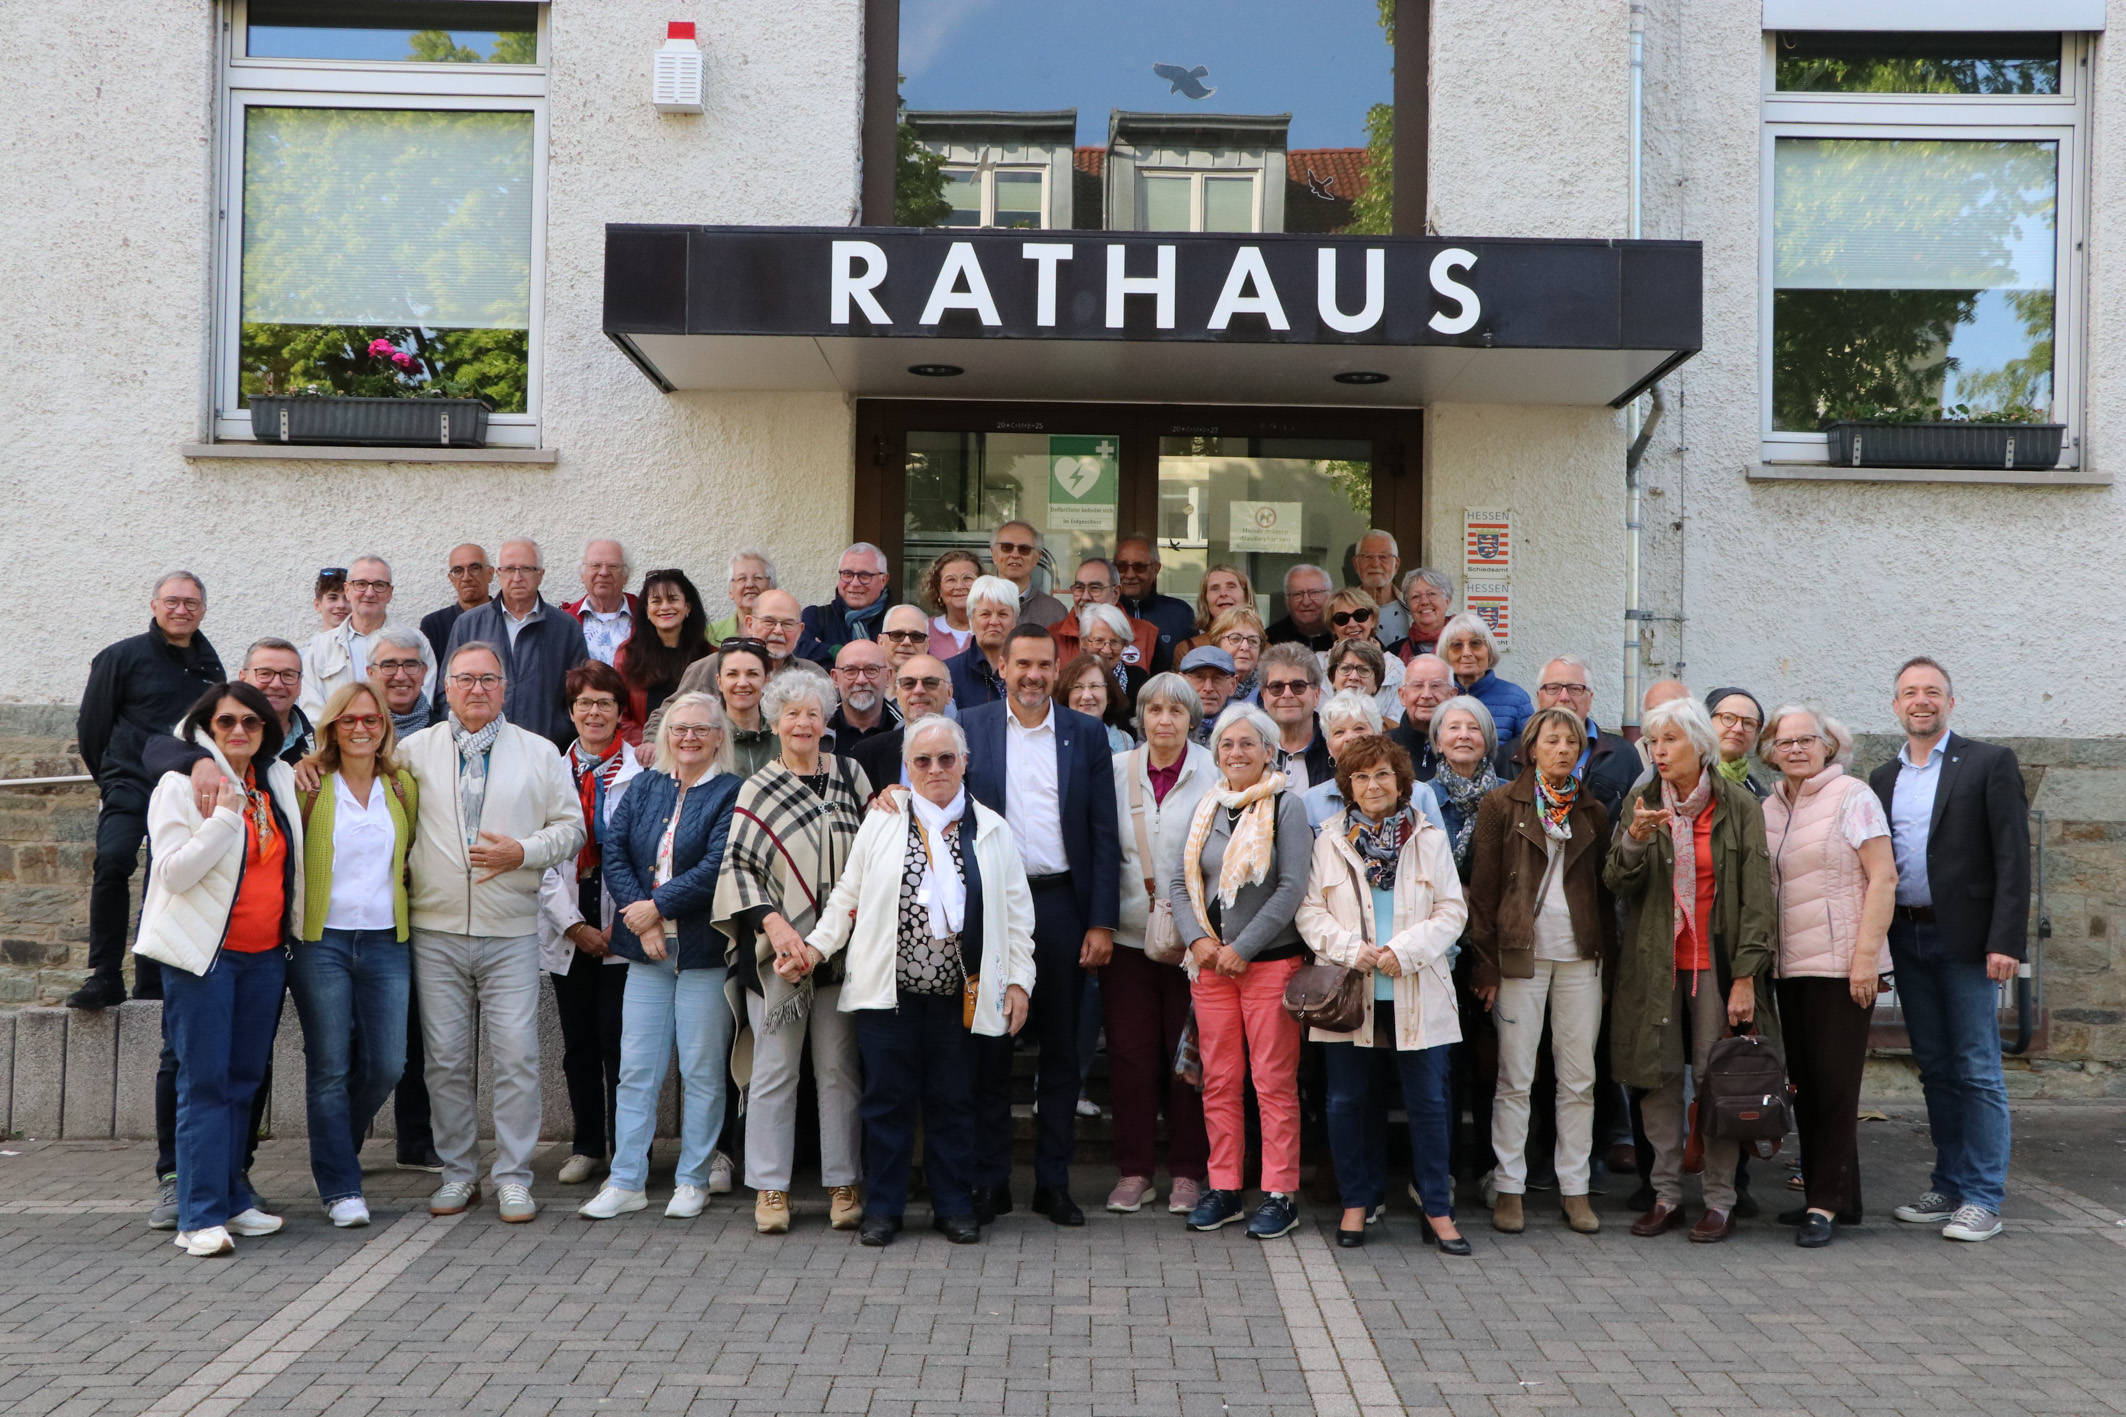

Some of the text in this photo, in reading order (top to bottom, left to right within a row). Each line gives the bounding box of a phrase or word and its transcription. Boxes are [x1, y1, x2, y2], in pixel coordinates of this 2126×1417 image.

[831, 241, 1482, 334] RATHAUS
[1467, 511, 1510, 521] HESSEN
[1466, 583, 1509, 593] HESSEN
